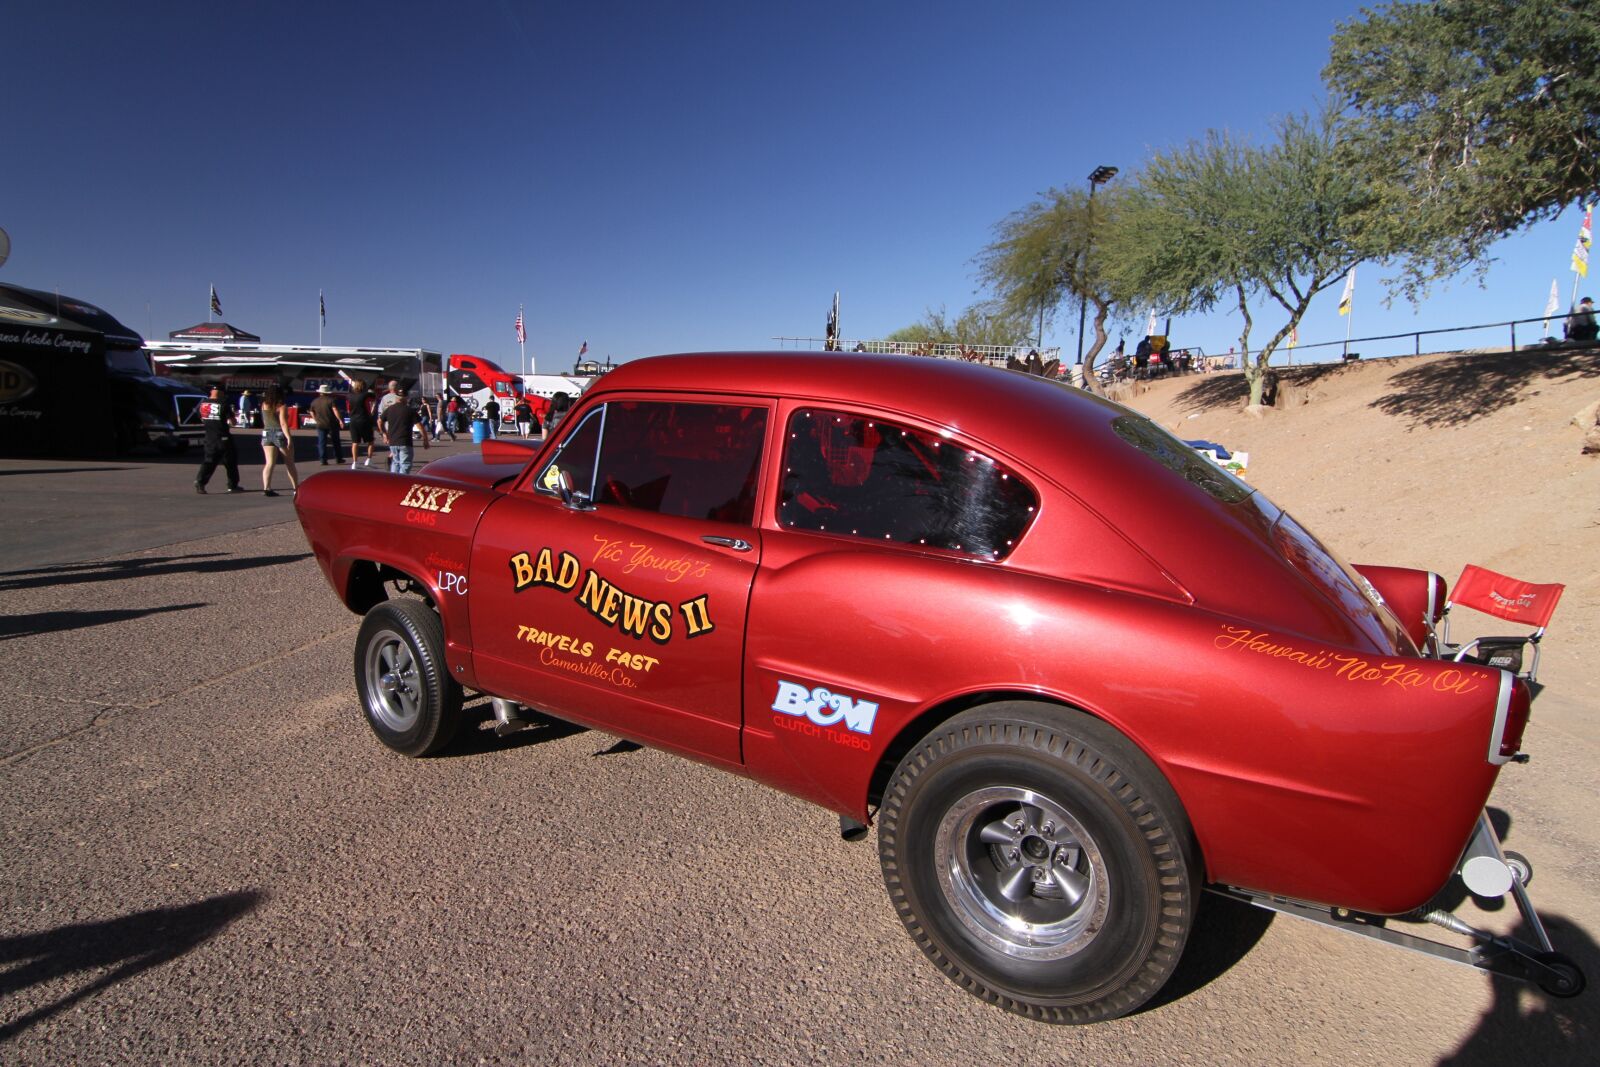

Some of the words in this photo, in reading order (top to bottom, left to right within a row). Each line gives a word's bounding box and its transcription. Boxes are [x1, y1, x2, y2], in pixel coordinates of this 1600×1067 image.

[22, 330, 52, 346] Intake
[54, 333, 92, 354] Company
[400, 484, 466, 513] ISKY
[406, 510, 436, 526] CAMS
[593, 534, 624, 563] Vic
[623, 543, 712, 583] Young's
[438, 570, 468, 595] LPC
[510, 547, 581, 593] BAD
[575, 568, 673, 644] NEWS
[679, 594, 716, 639] II
[516, 625, 594, 657] TRAVELS
[605, 648, 660, 673] FAST
[771, 680, 879, 735] B&M
[773, 715, 820, 738] CLUTCH
[824, 728, 872, 752] TURBO
